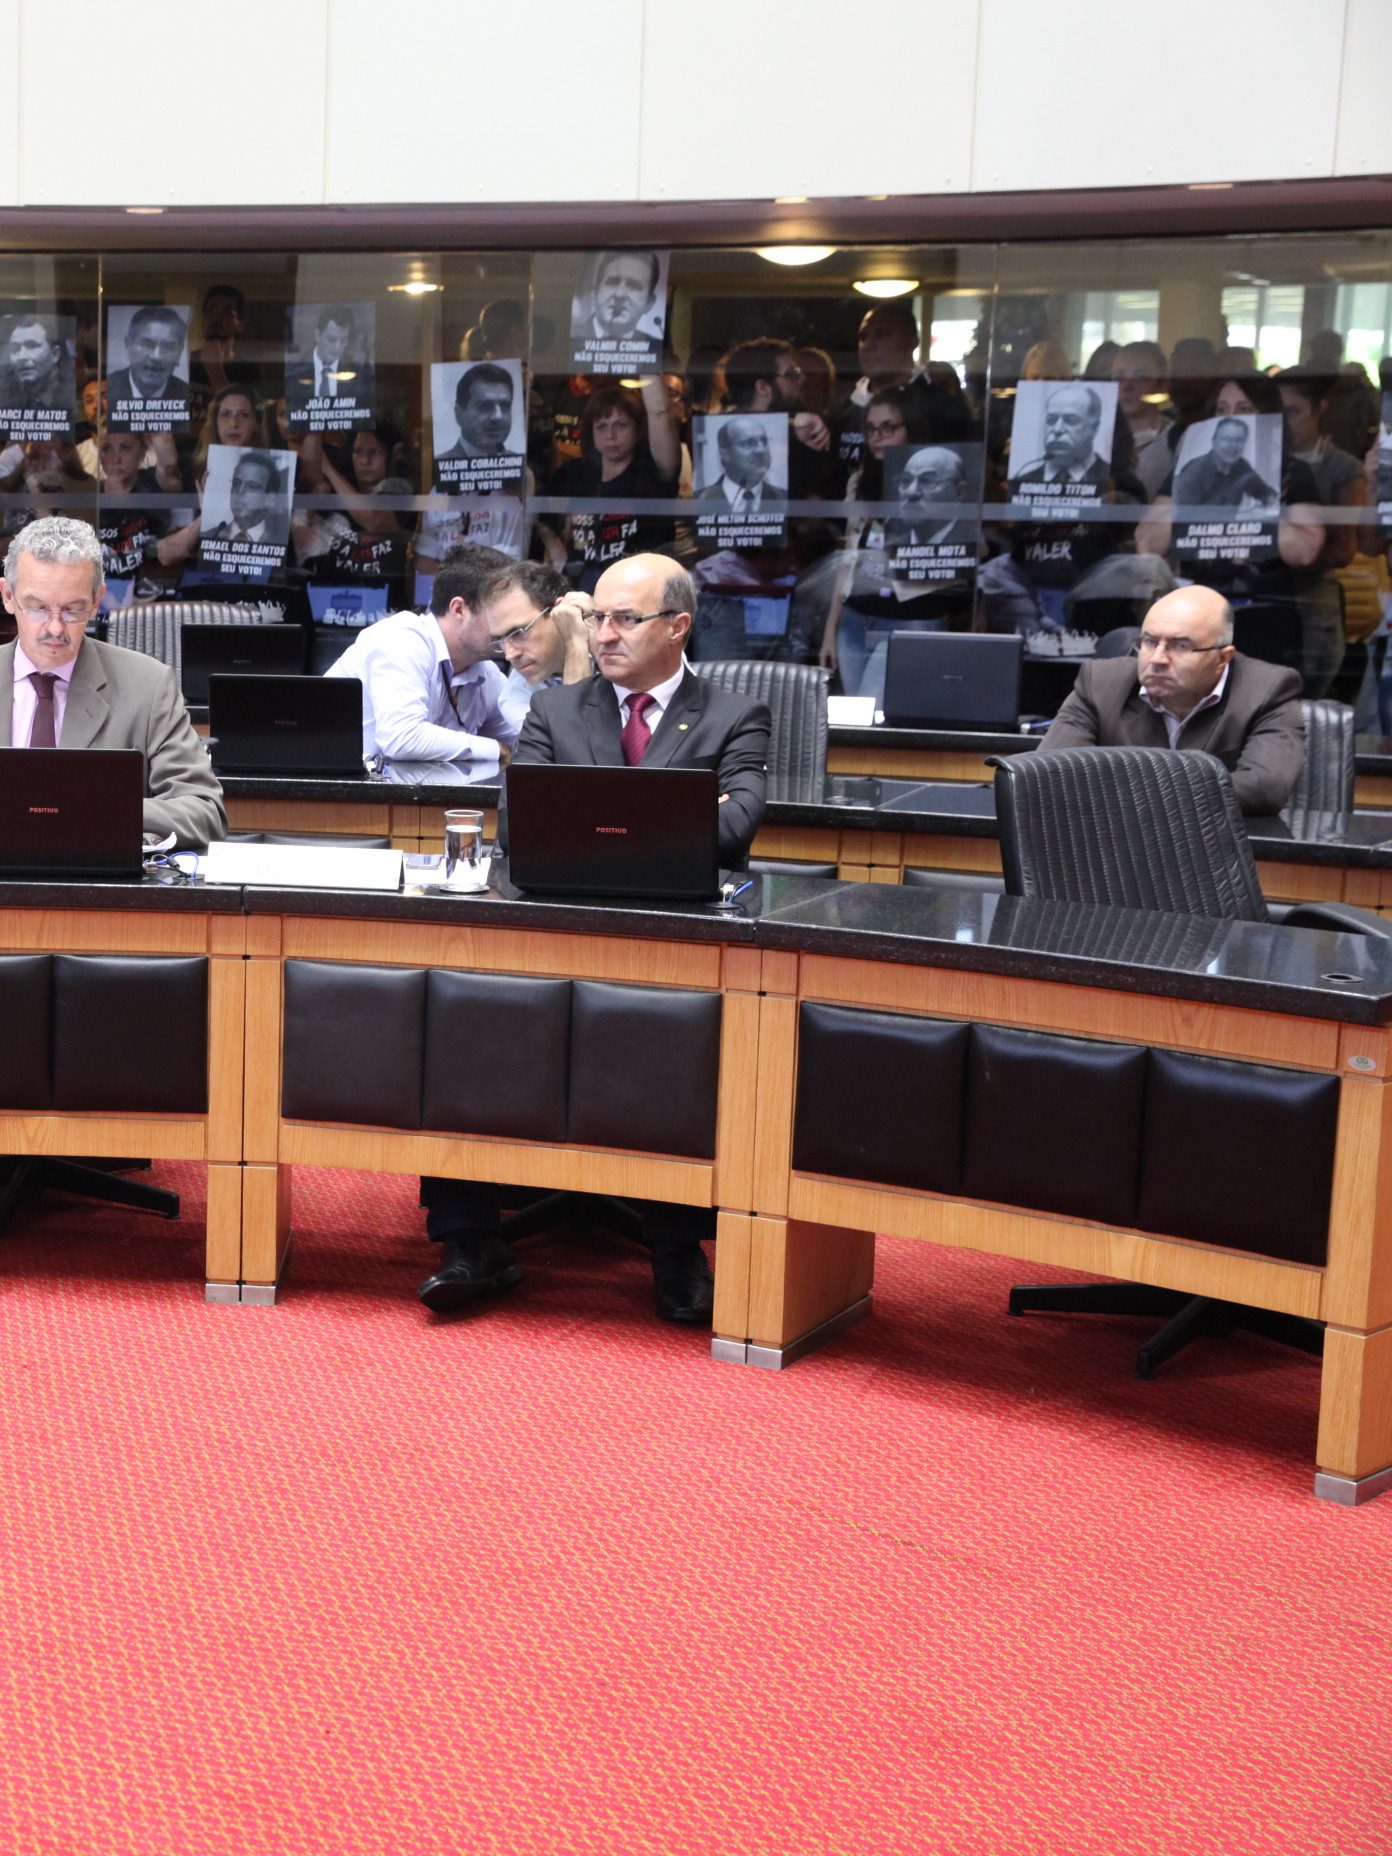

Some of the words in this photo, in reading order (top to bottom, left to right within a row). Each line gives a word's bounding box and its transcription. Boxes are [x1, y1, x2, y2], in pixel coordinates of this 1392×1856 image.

[585, 340, 617, 351] VALMIR
[619, 341, 650, 352] COMIN
[116, 400, 144, 410] SILVIO
[146, 400, 186, 410] DREVECK
[305, 397, 330, 409] JOÃO
[333, 397, 356, 408] AMIN
[23, 409, 35, 420] DE
[37, 410, 67, 420] MATOS
[112, 411, 129, 421] NÃO
[131, 412, 190, 422] ESQUECEREMOS
[290, 410, 308, 420] NÃO
[310, 409, 371, 420] ESQUECEREMOS
[11, 421, 70, 431] ESQUECEREMOS
[130, 422, 145, 431] SEU
[147, 422, 172, 432] VOTO!
[309, 421, 324, 431] SEU
[327, 420, 352, 430] VOTO!
[9, 431, 25, 440] SEU
[27, 432, 52, 441] VOTO!
[440, 471, 458, 481] NÃO
[460, 468, 521, 481] ESQUECEREMOS
[459, 482, 475, 491] SEU
[477, 480, 502, 490] VOTO!
[698, 525, 717, 536] NÃO
[718, 525, 783, 536] ESQUECEREMOS
[201, 539, 229, 551] ISMAEL
[232, 542, 249, 553] DOS
[251, 544, 286, 556] SANTOS
[718, 537, 734, 547] SEU
[736, 537, 763, 547] VOTO!
[371, 540, 393, 559] FAZ
[203, 551, 220, 561] NÃO
[222, 553, 281, 567] ESQUECEREMOS
[221, 563, 236, 573] SEU
[238, 565, 262, 575] VOTO!
